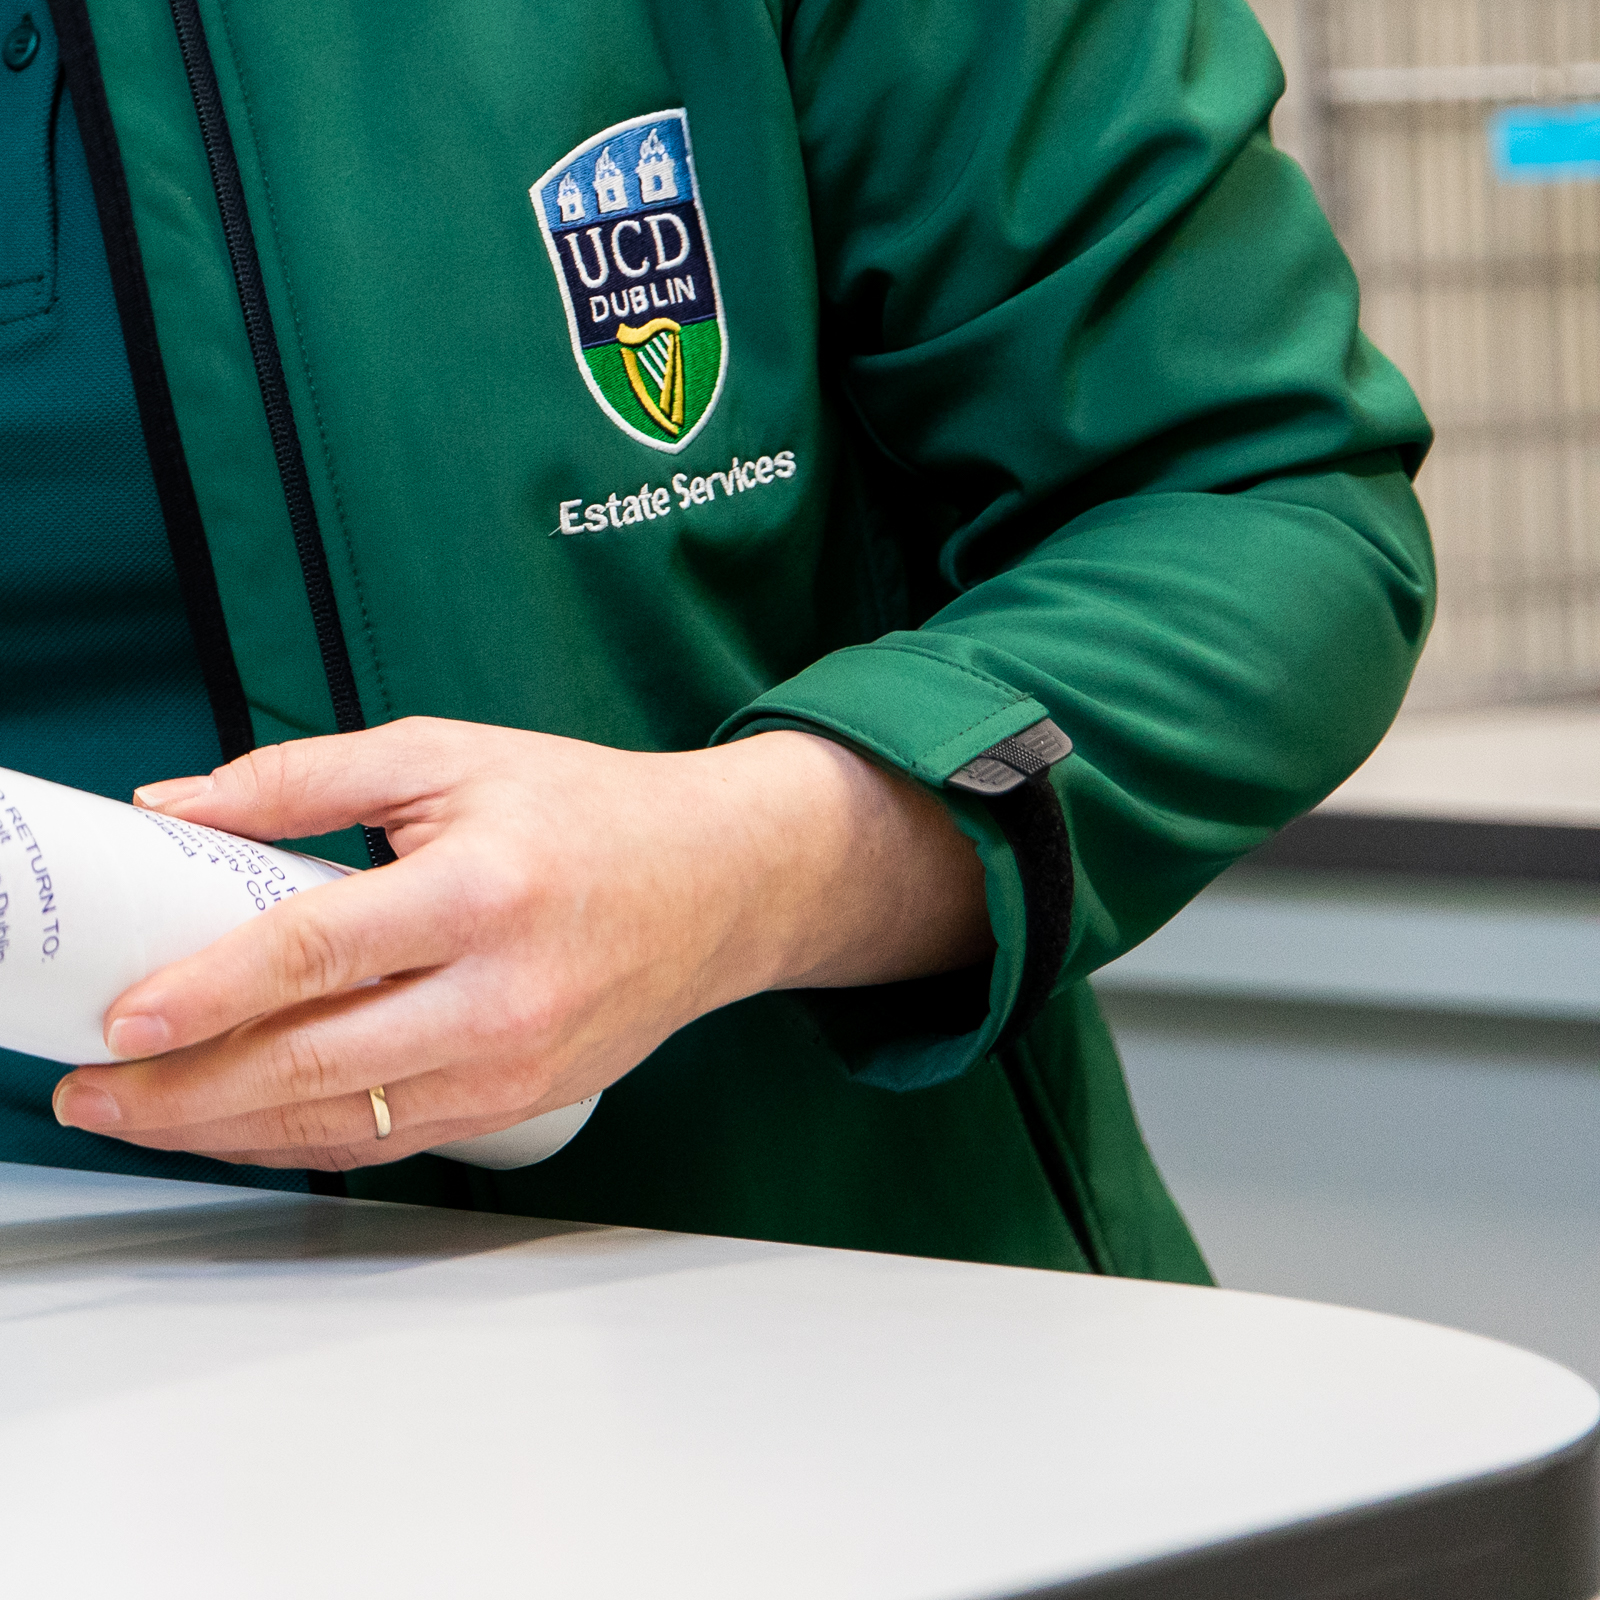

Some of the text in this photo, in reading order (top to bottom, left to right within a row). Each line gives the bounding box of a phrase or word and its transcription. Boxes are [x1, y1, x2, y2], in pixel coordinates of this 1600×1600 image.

[563, 211, 691, 290] UCD
[589, 273, 697, 324] DUBLIN
[557, 450, 797, 536] Estate Services
[5, 805, 61, 963] RETURN TO:
[207, 853, 221, 865] 4
